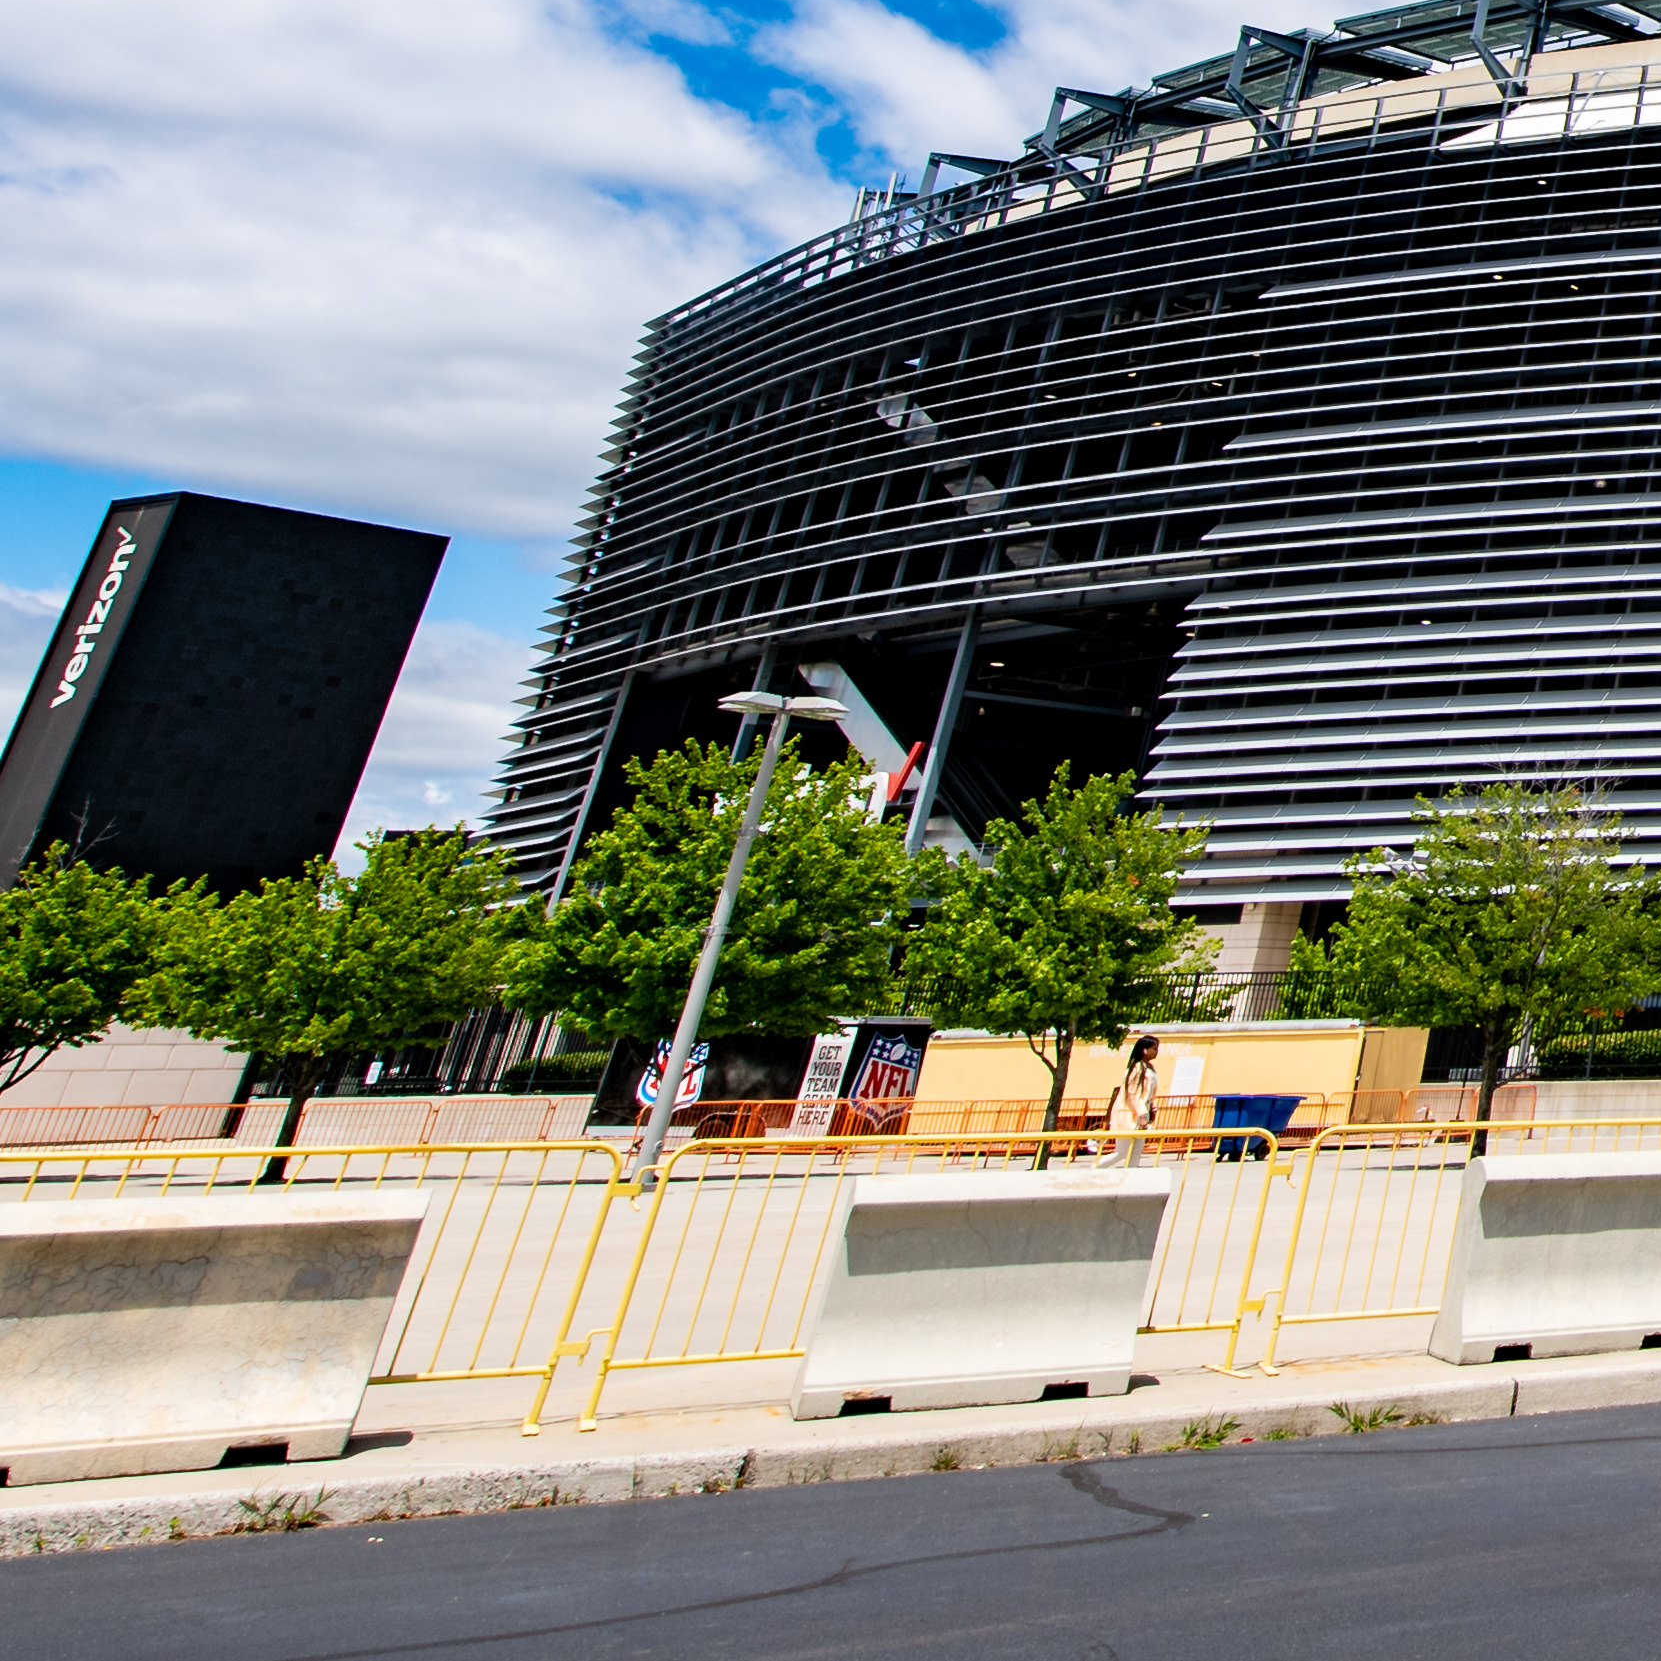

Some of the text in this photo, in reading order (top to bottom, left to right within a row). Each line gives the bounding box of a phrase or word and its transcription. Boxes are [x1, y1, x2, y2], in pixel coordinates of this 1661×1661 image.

[50, 542, 137, 709] verizon
[818, 1045, 842, 1060] GET
[812, 1061, 842, 1077] YOUR
[806, 1078, 839, 1093] TEAM
[859, 1059, 910, 1104] NFL
[796, 1110, 829, 1125] HERE
